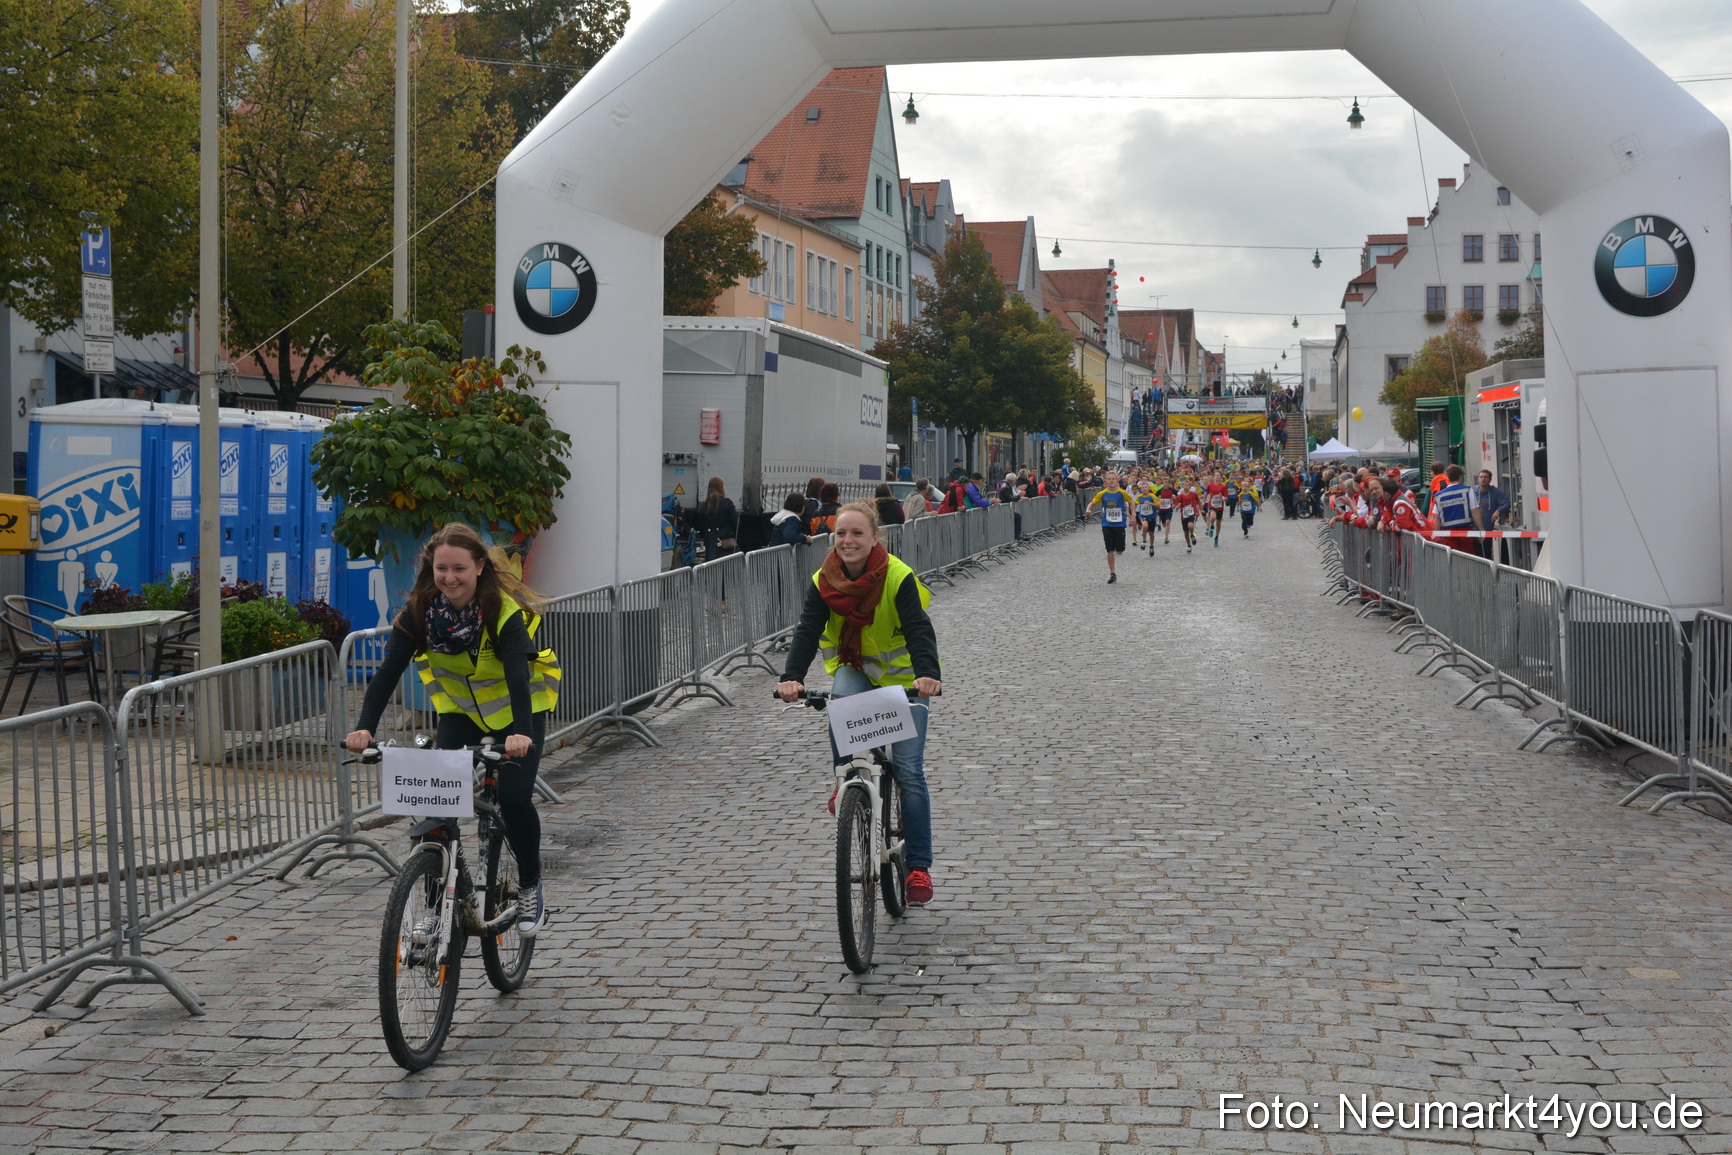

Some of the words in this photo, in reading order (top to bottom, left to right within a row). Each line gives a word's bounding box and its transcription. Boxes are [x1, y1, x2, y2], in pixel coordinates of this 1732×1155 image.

[1602, 216, 1687, 253] BMW
[88, 226, 104, 266] P
[518, 244, 591, 275] BMW
[85, 290, 111, 300] Parkschein
[87, 301, 109, 312] werktags
[18, 397, 26, 417] 3
[1200, 417, 1235, 426] START
[846, 717, 873, 729] Erste
[874, 710, 898, 722] Frau
[849, 722, 904, 744] Jugendlauf
[394, 775, 428, 787] Erster
[430, 778, 462, 788] Mann
[396, 793, 460, 806] Jugendlauf
